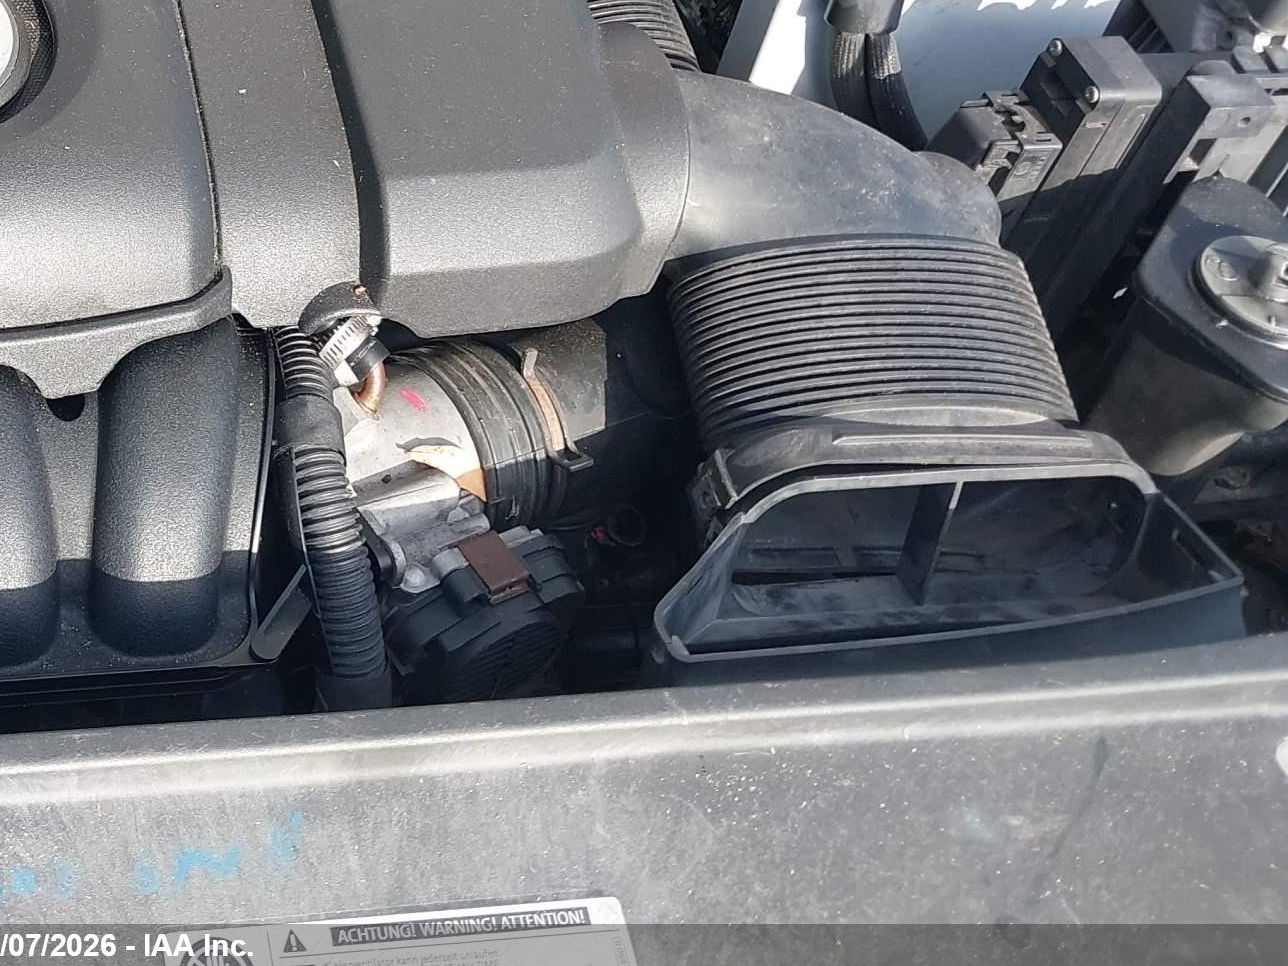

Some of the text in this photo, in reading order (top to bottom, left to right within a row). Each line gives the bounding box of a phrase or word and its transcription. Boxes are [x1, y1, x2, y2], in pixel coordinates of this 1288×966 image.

[337, 909, 586, 944] ACHTUNG! WARNING! ATTENTION!
